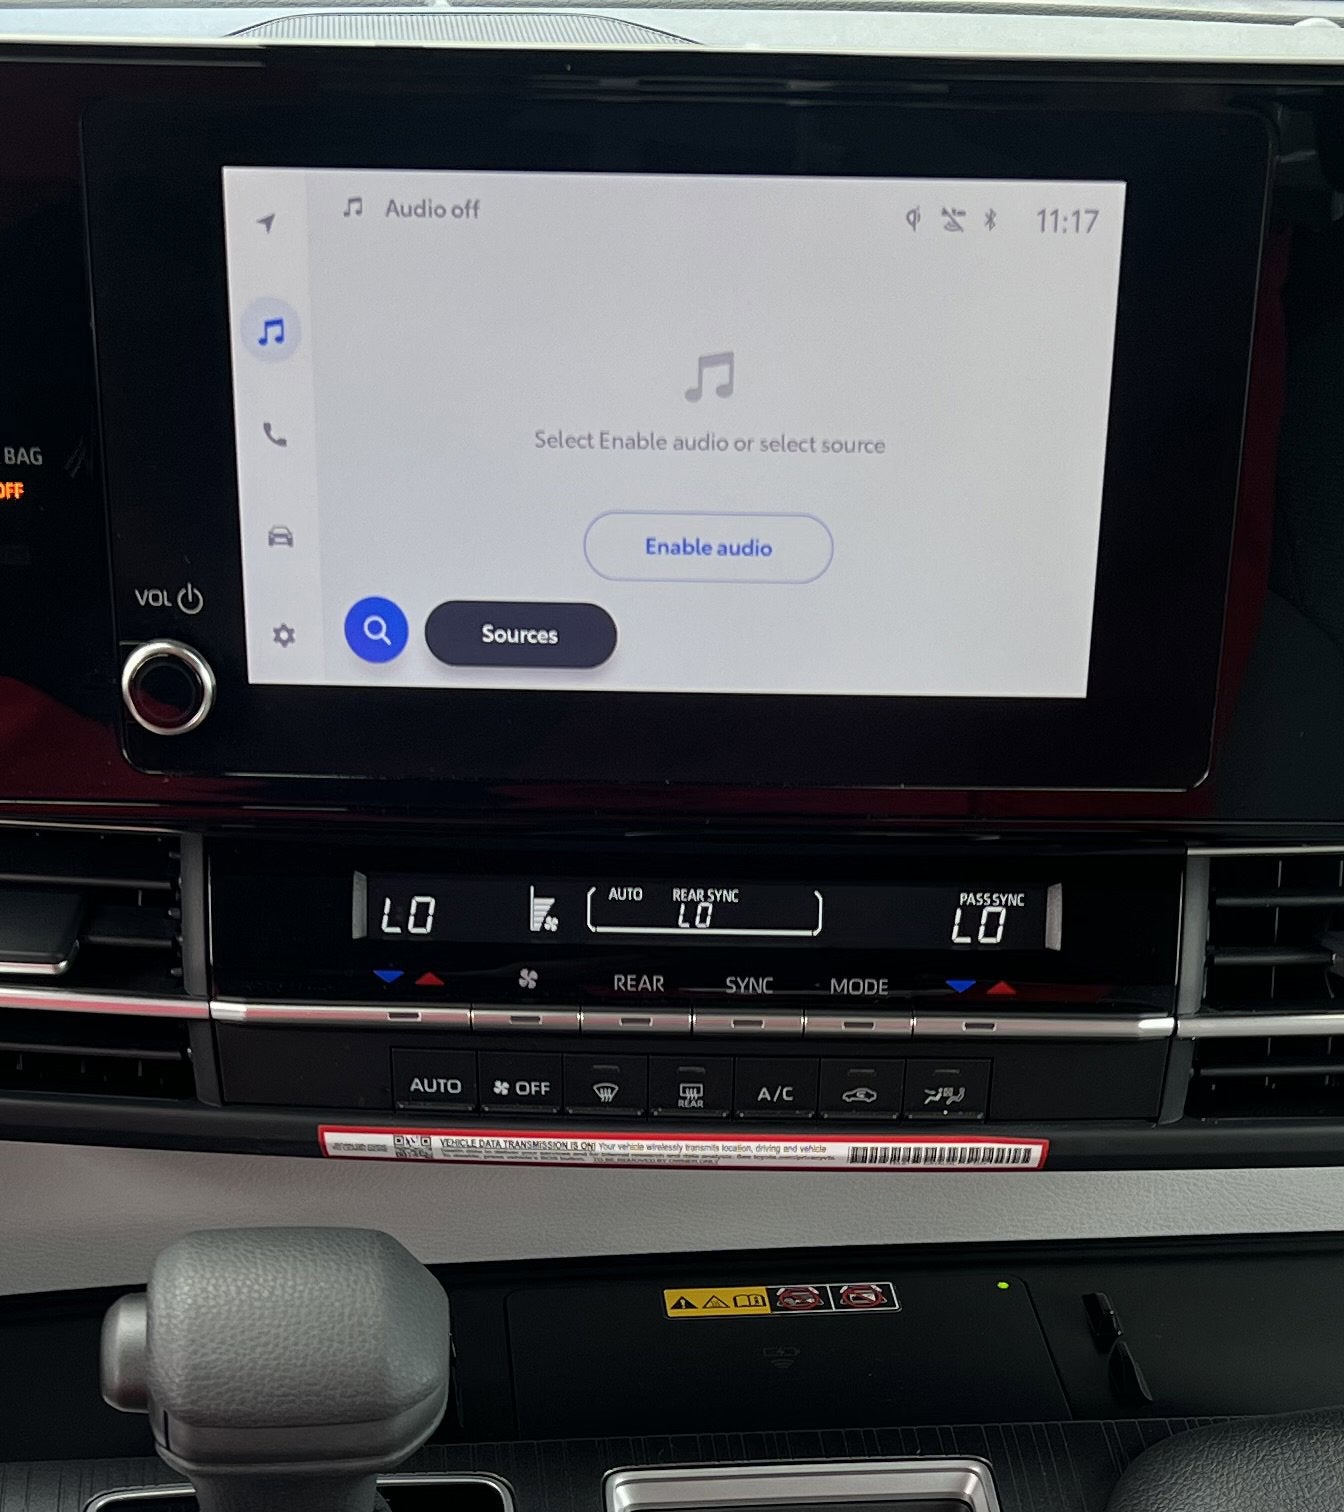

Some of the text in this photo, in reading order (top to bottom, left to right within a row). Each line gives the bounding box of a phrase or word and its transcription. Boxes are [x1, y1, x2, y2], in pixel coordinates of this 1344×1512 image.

[385, 199, 480, 219] Audio off
[1036, 210, 1099, 234] 11:17
[535, 430, 886, 454] Select Enable audio or select source
[4, 447, 43, 465] BAG
[645, 538, 773, 557] Enable audio
[135, 590, 172, 607] VOL
[481, 625, 558, 644] Sources
[609, 888, 643, 901] AUTO
[673, 888, 739, 903] REAR SYNC
[960, 893, 1024, 907] PASS SYNC
[614, 975, 664, 991] REAR
[726, 977, 774, 994] SYNC
[830, 978, 889, 995] MODE
[410, 1078, 462, 1093] AUTO
[515, 1081, 550, 1095] OFF
[758, 1087, 793, 1101] A/C
[439, 1138, 476, 1149] VEHICLE
[479, 1139, 501, 1149] DATA
[504, 1140, 567, 1151] TRANSMISSION
